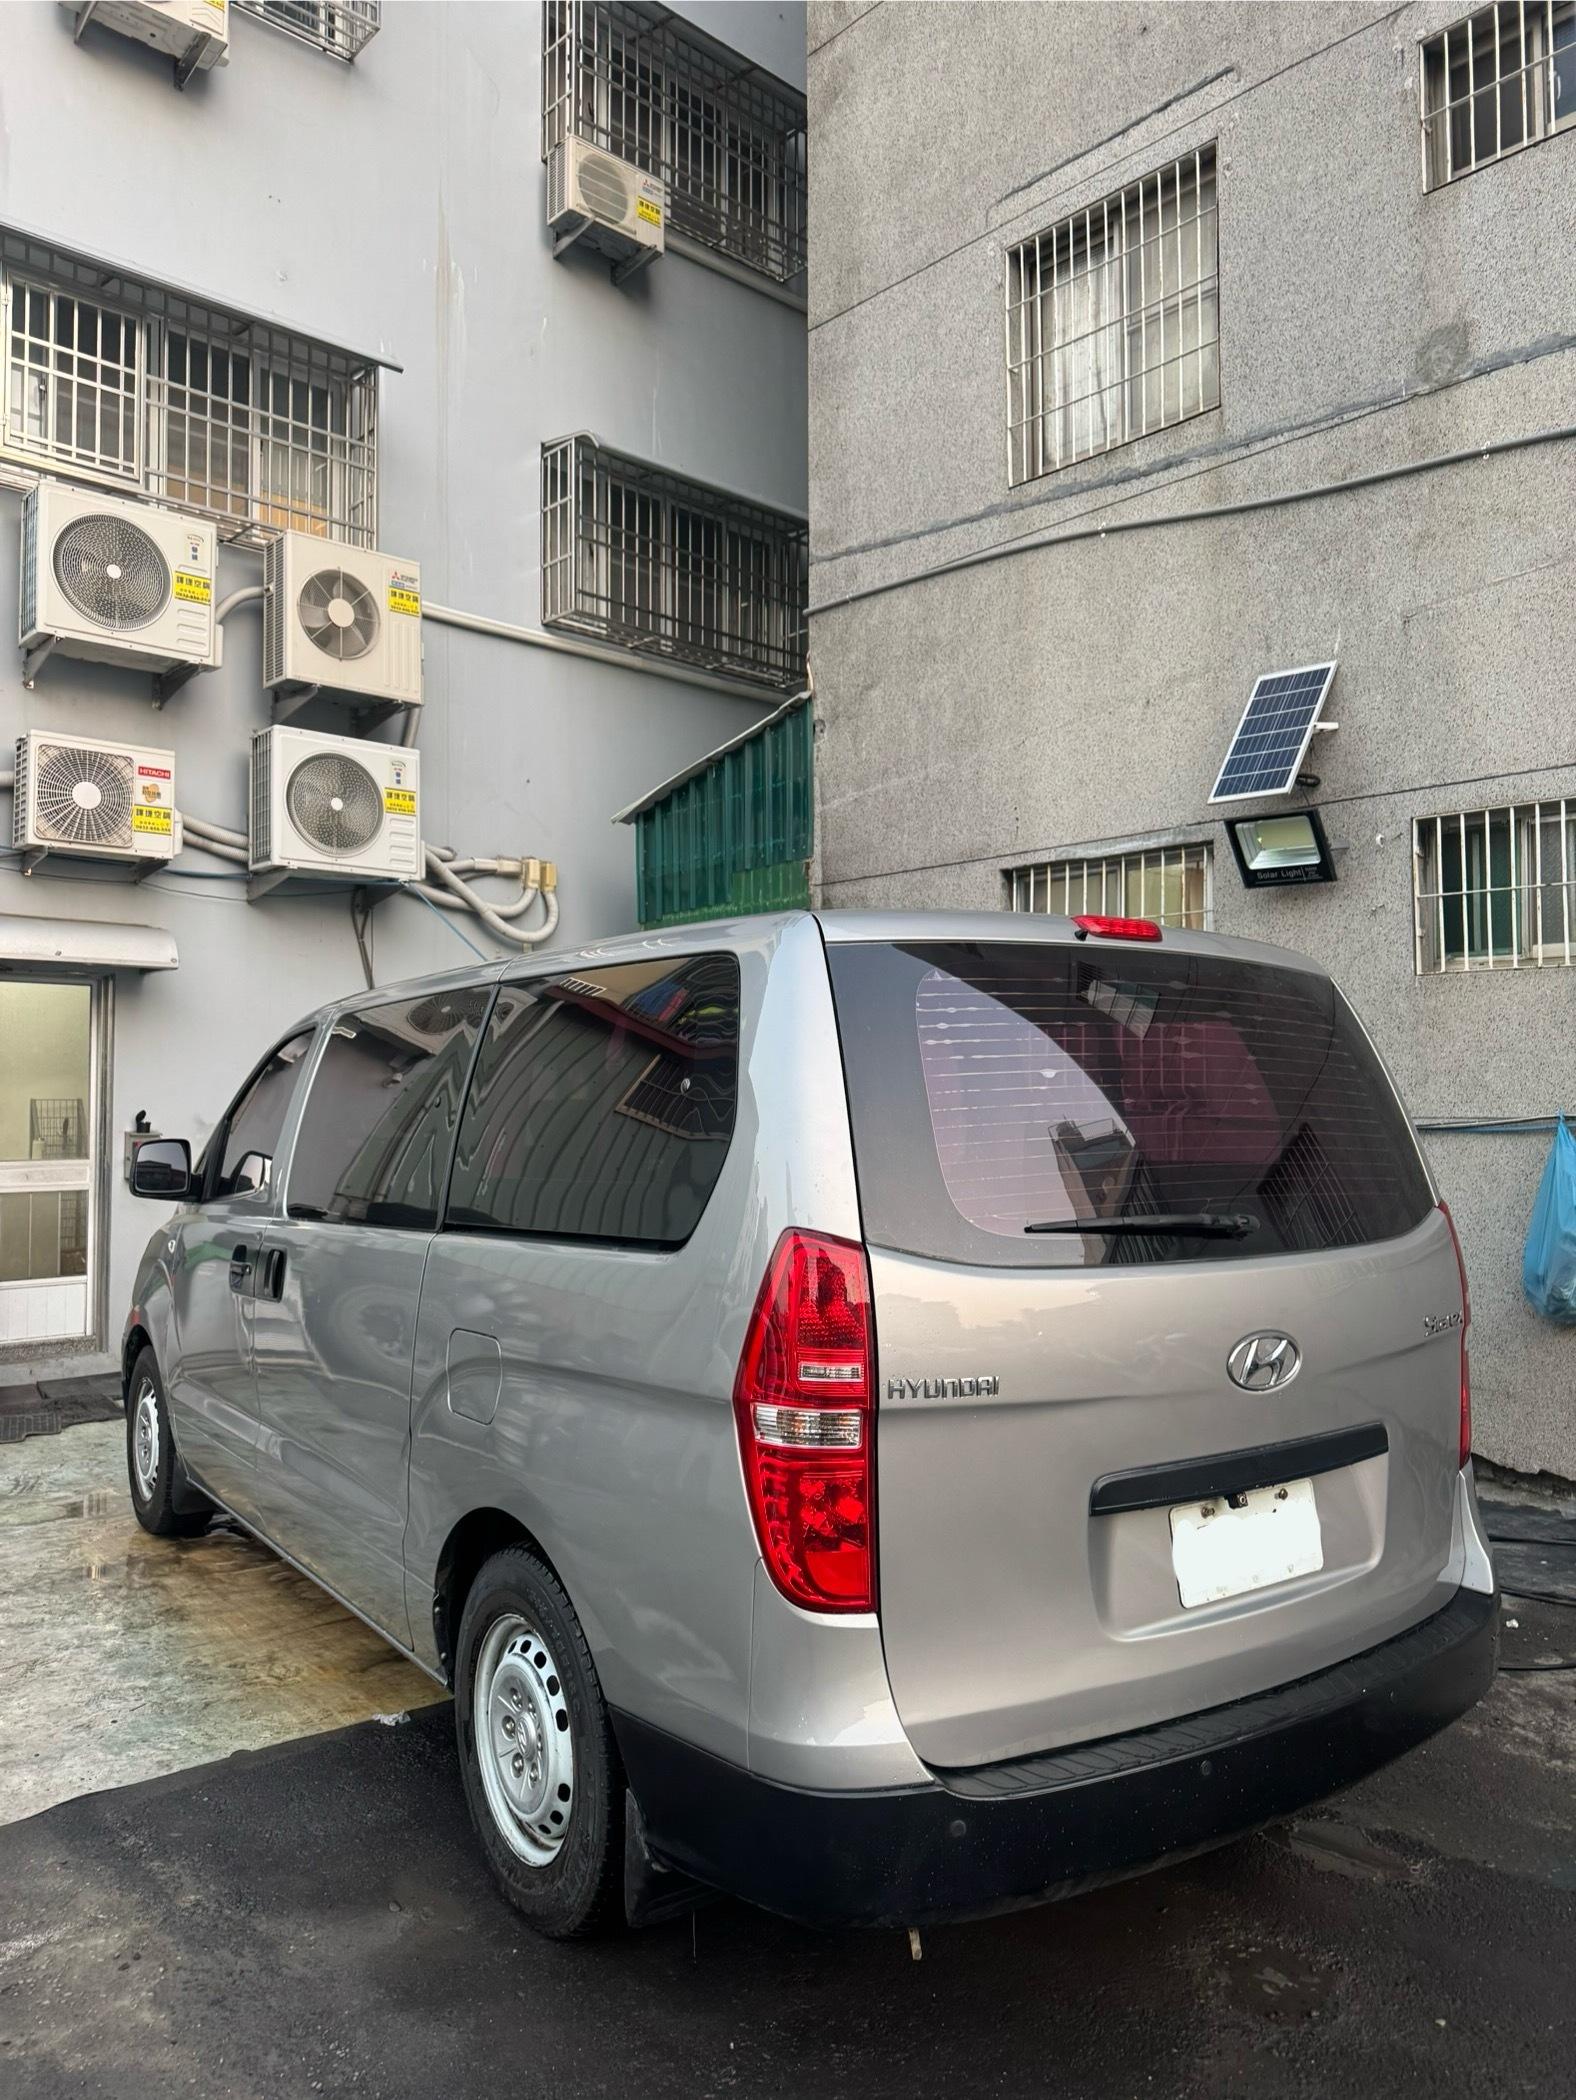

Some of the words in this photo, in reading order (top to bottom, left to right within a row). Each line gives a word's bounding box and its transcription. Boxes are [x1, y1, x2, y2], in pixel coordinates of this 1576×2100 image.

[140, 767, 170, 778] HITACHI
[1256, 871, 1278, 880] Solar
[1280, 868, 1302, 878] Light
[887, 1375, 1000, 1400] HYUNDAI
